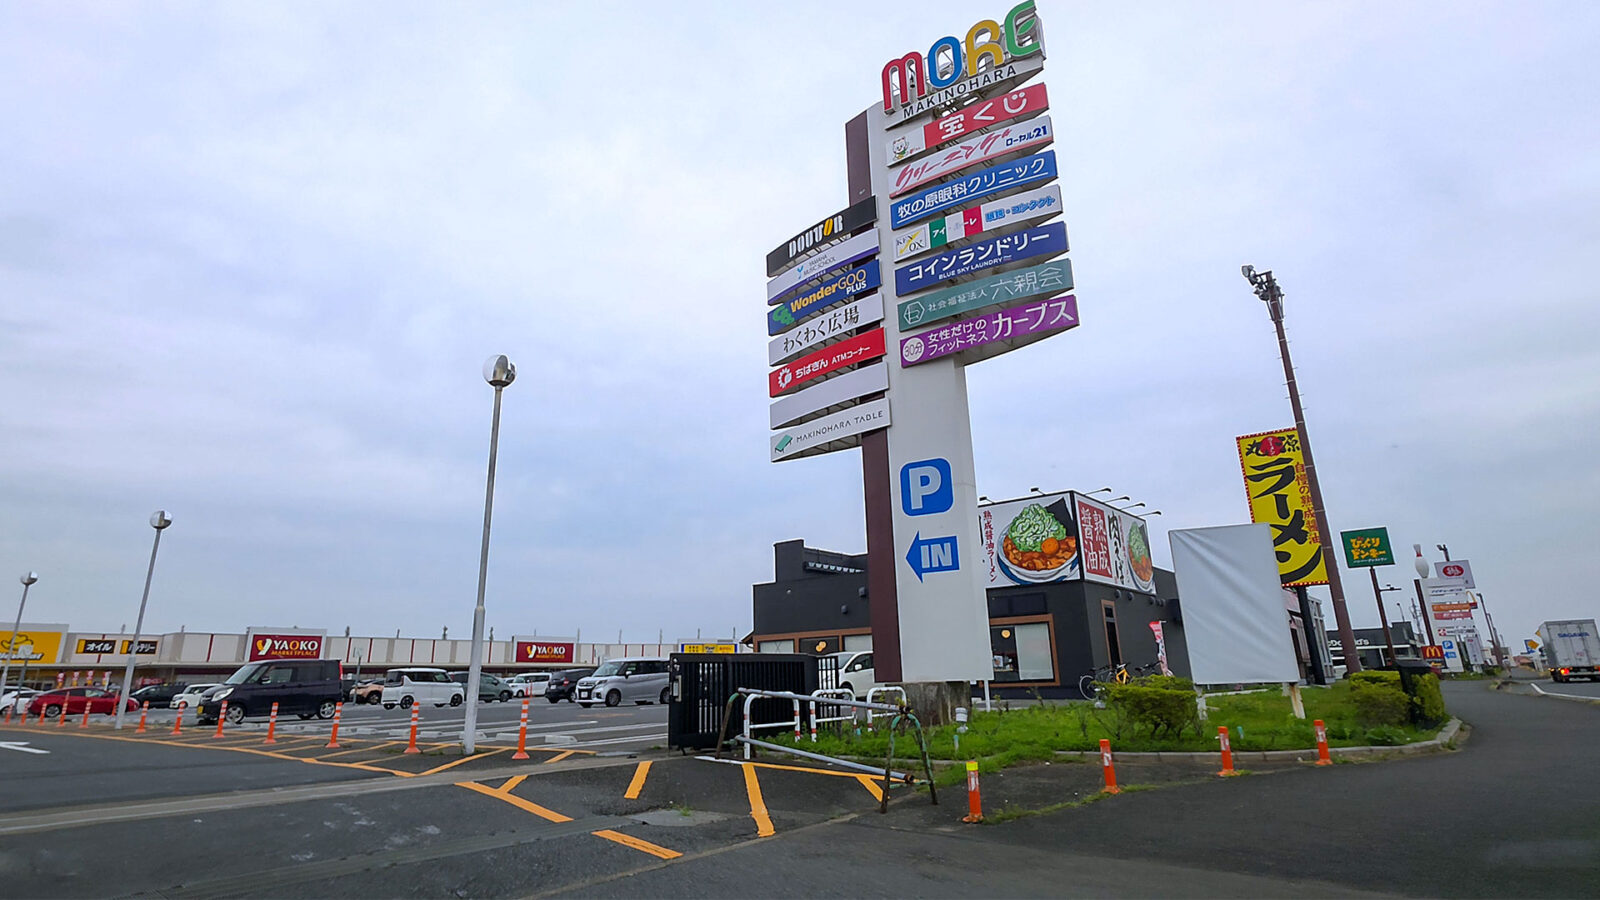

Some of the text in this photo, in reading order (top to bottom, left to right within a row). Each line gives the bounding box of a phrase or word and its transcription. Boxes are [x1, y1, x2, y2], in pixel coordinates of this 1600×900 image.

[902, 65, 1017, 119] MAKINOHARA
[939, 91, 1027, 140] 宝くじ
[1005, 125, 1048, 147] ローヤル21
[898, 158, 1045, 218] 牧の原眼科クリニック
[788, 215, 844, 258] DOUTOR
[909, 233, 1050, 282] コインランドリー
[846, 281, 867, 295] PLUS
[927, 266, 1063, 312] 社会福祉法人 六親会
[938, 270, 956, 280] BLUE
[956, 266, 971, 275] SKY
[970, 256, 1002, 270] LAUNDRY
[790, 269, 867, 312] WonderGOO
[783, 305, 860, 353] わくわく広場
[927, 301, 1074, 344] 女性だけの カーブス
[928, 331, 988, 356] フィットネス
[795, 346, 871, 379] ちばぎん ATMコーナー
[904, 343, 923, 357] 30分
[796, 410, 883, 442] MAKINOHARA TABLE
[908, 465, 942, 510] P
[1080, 506, 1098, 570] 醤油
[1092, 510, 1112, 574] 熟成
[1245, 457, 1322, 584] ラーメン
[921, 542, 952, 569] IN
[983, 510, 998, 582] 熟成醤油ラーメン
[1351, 548, 1387, 560] ドンキー
[86, 642, 112, 651] オイル
[273, 640, 318, 650] YAOKO
[537, 645, 566, 654] YAOKO
